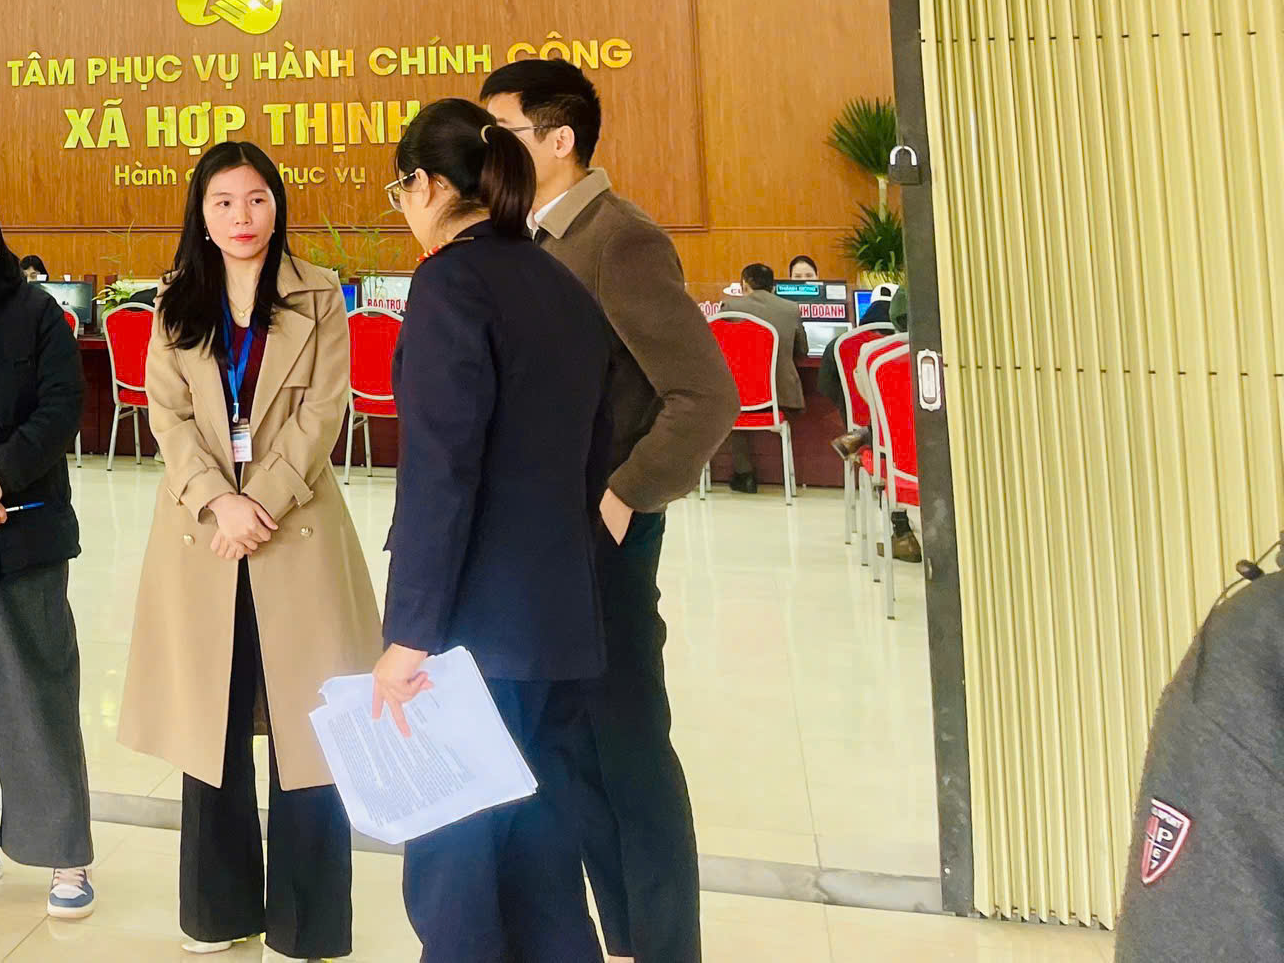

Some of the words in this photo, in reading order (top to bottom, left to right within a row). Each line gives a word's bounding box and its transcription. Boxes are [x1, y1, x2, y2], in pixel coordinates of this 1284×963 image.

[7, 51, 76, 86] TÂM
[87, 54, 183, 91] PHỤC
[192, 53, 240, 90] VỤ
[253, 41, 355, 80] HÀNH
[368, 35, 492, 76] CHÍNH
[507, 30, 633, 70] CÔNG
[63, 98, 131, 149] XÃ
[146, 100, 246, 156] HỢP
[263, 100, 421, 153] THỊNH
[114, 160, 177, 187] Hành
[279, 163, 325, 190] hục
[334, 166, 366, 190] vụ
[811, 303, 846, 318] DOANH
